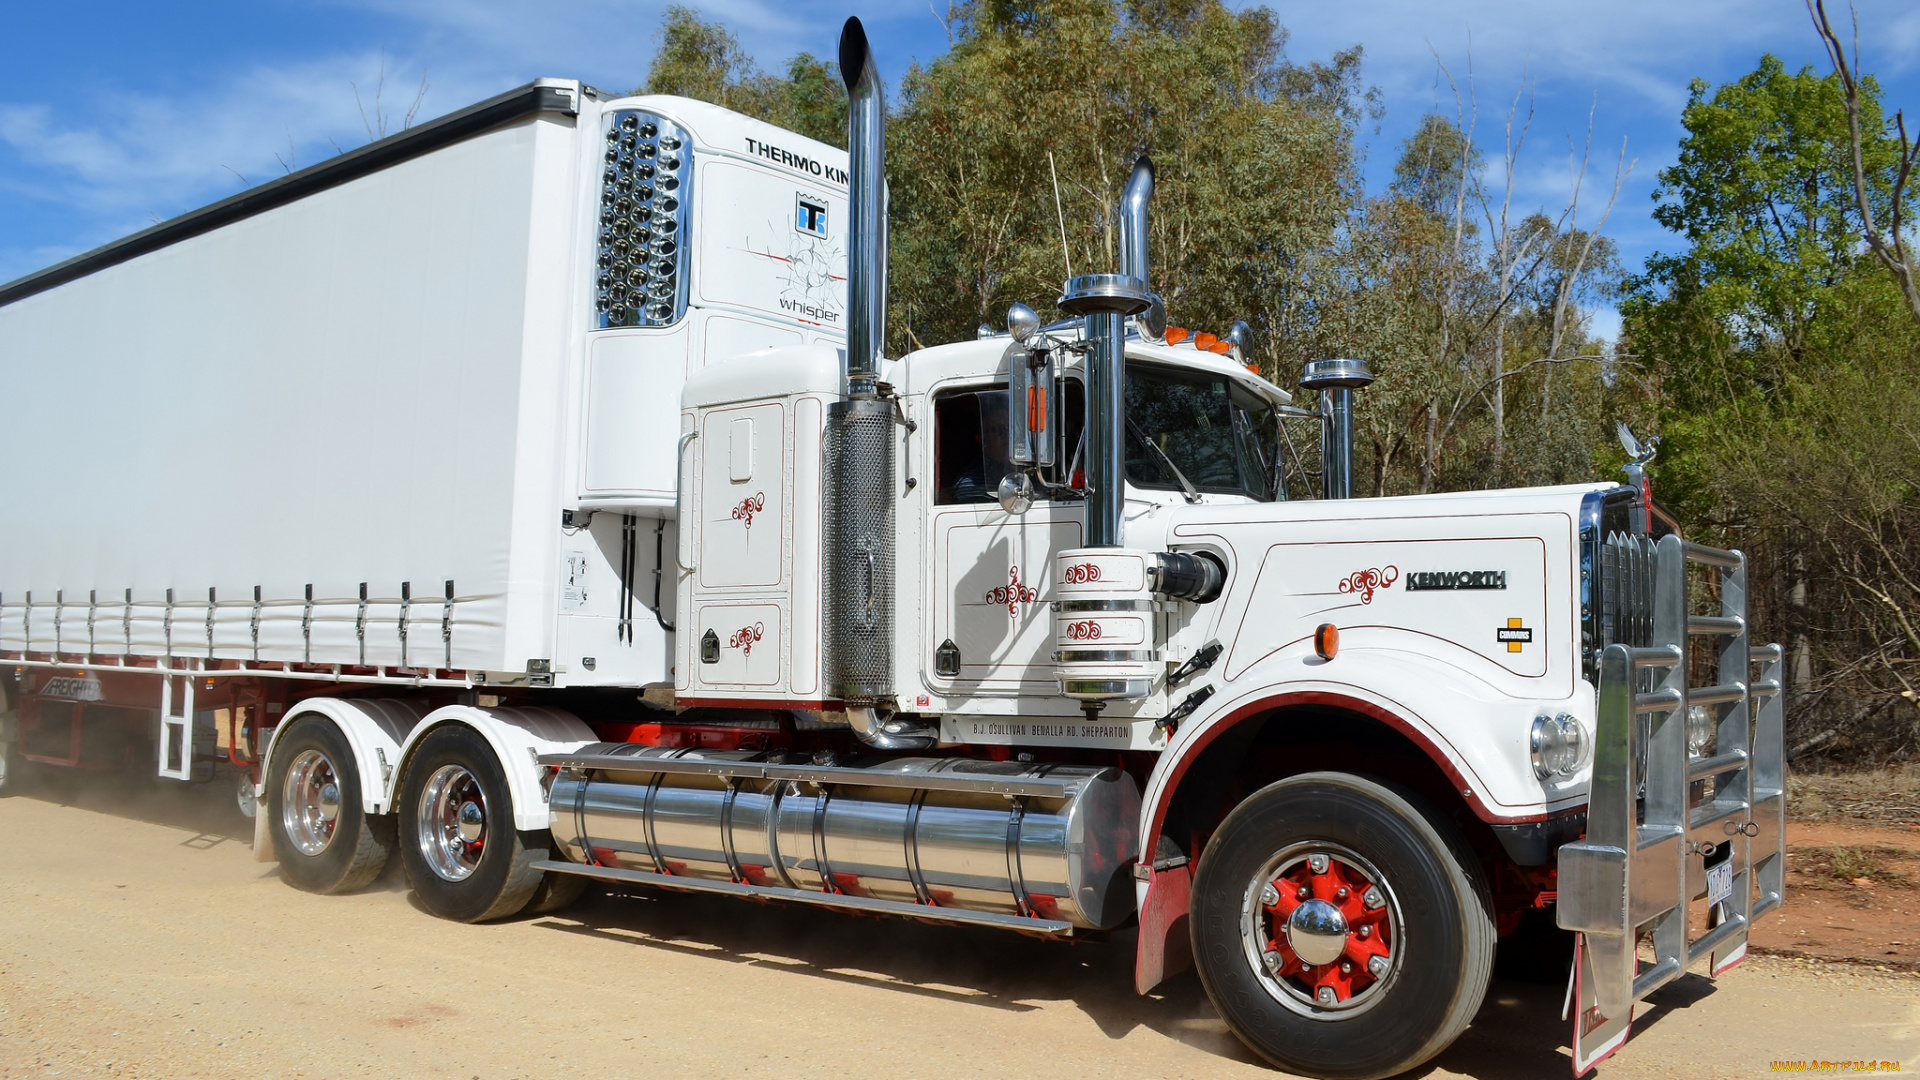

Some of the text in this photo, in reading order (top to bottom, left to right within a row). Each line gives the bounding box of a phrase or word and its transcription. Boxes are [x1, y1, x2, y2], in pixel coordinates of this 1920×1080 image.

[745, 138, 848, 186] THERMO KIN
[780, 298, 839, 322] whisper
[1406, 571, 1506, 588] KENWORTH
[42, 679, 101, 698] FREIGHTER
[988, 722, 1026, 736] O'SULLIVAN
[1031, 725, 1064, 737] BENALLA
[1066, 725, 1079, 737] RD.
[1081, 726, 1129, 738] SHEPPARTON
